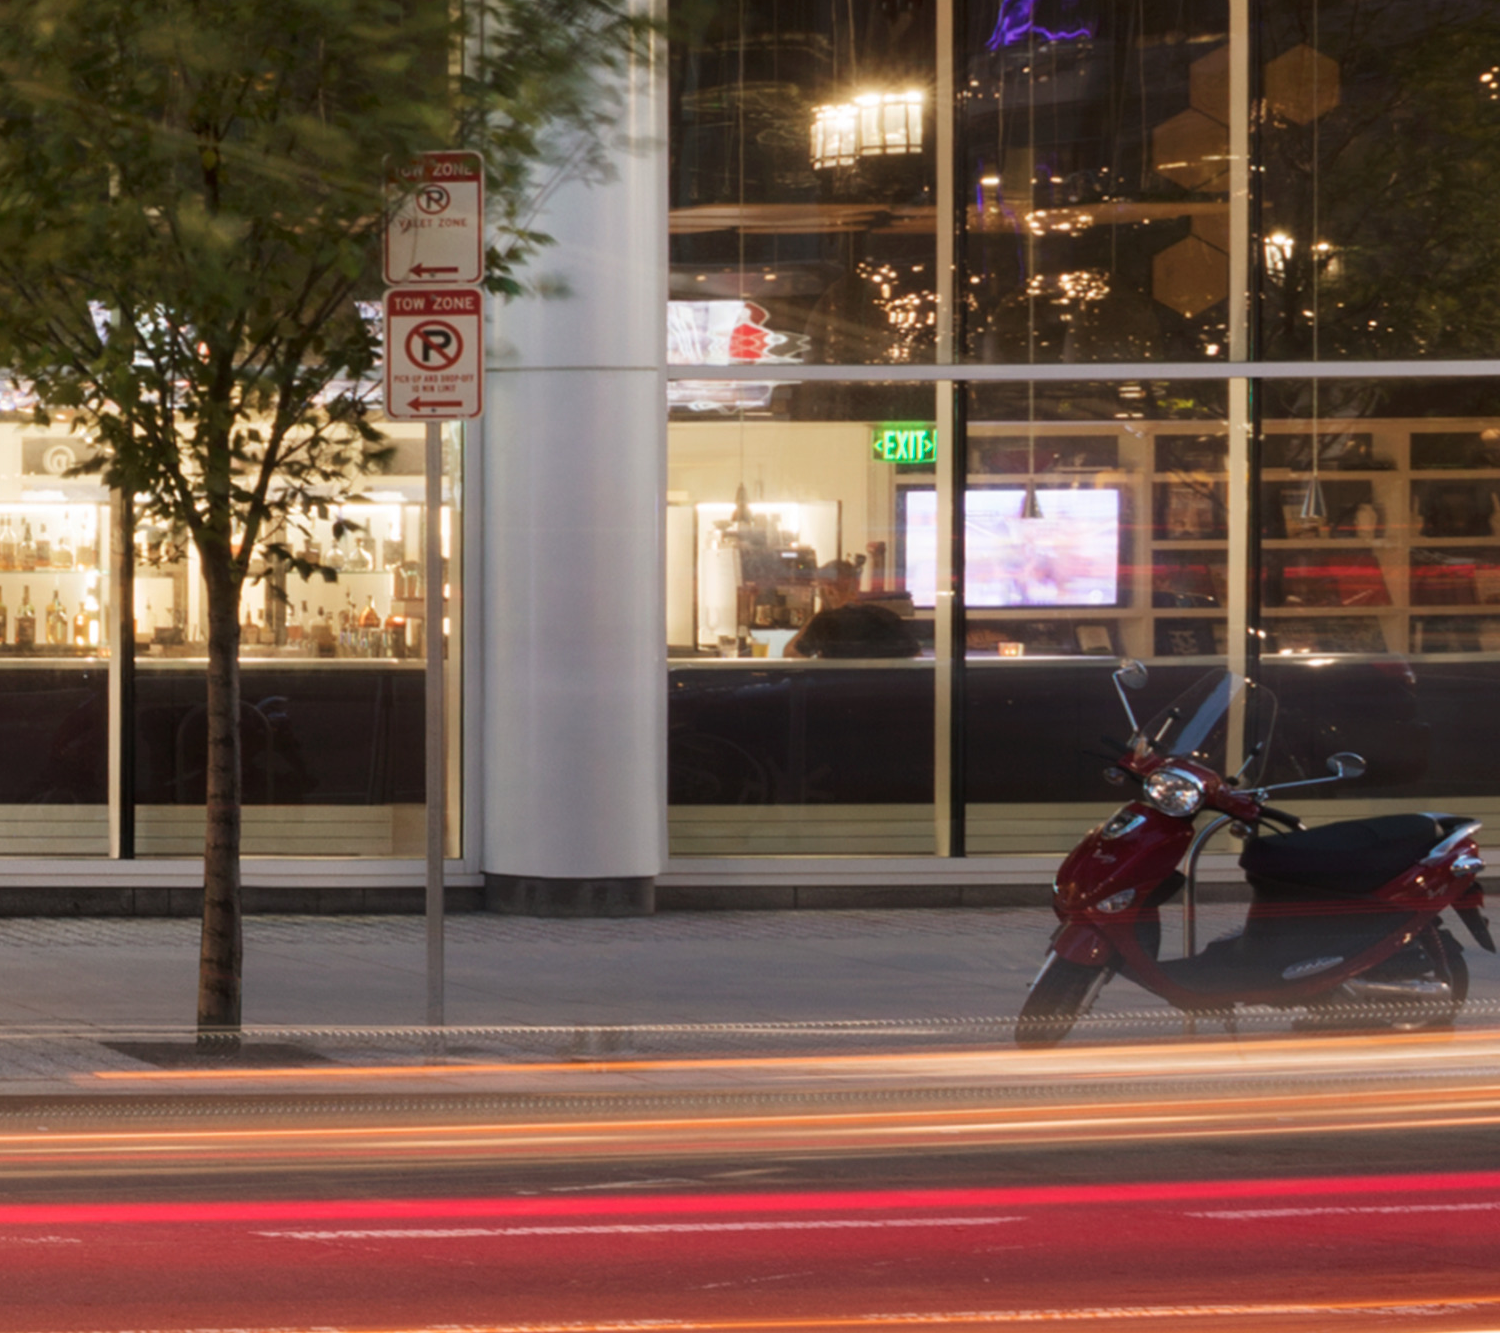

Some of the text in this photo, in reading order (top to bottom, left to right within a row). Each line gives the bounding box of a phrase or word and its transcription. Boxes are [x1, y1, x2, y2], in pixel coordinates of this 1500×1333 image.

[432, 162, 473, 177] ZONE
[398, 218, 468, 229] VALET ZONE
[394, 296, 475, 311] TOW ZONE
[424, 374, 438, 383] AND
[883, 430, 927, 460] EXIT
